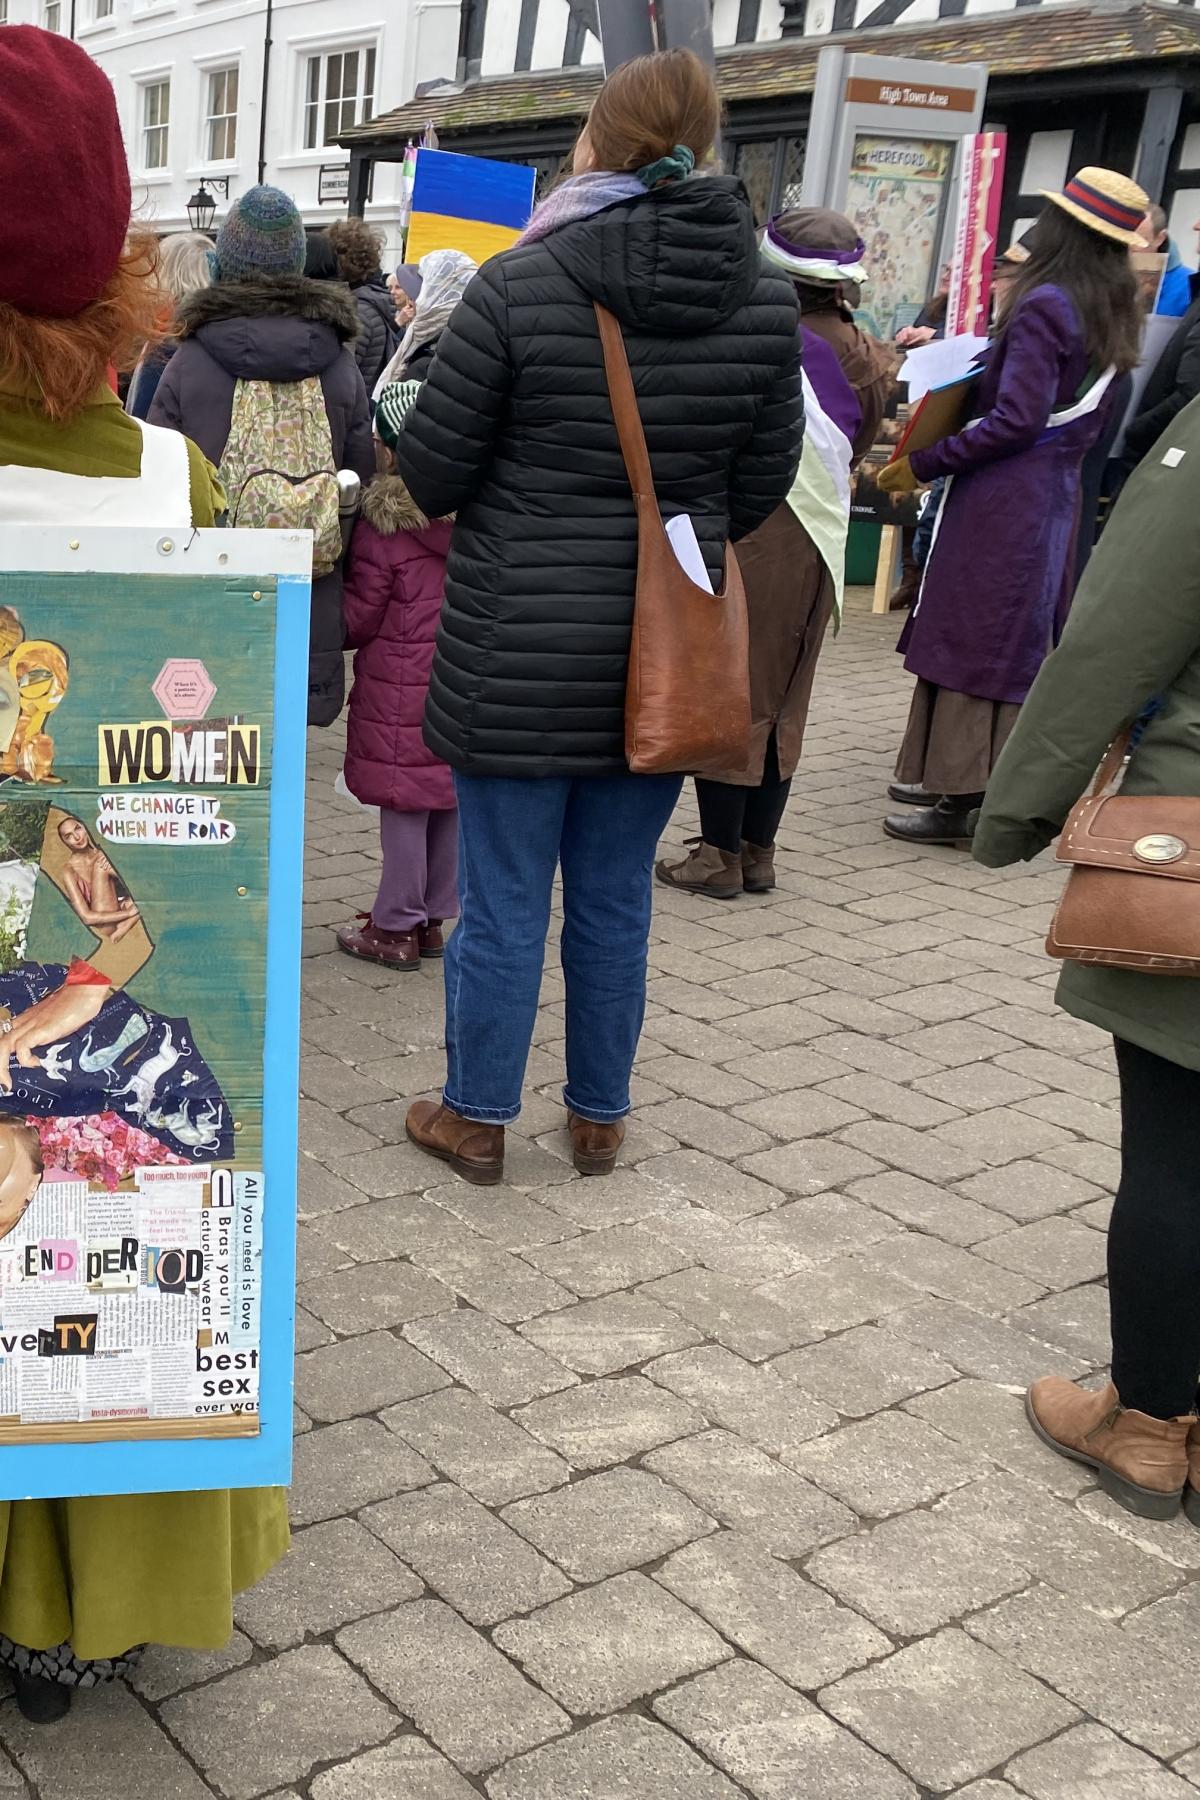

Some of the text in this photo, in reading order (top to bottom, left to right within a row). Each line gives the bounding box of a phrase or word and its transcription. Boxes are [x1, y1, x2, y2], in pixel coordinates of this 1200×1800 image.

[880, 86, 948, 106] High Town Area
[870, 150, 926, 167] HEREFORD
[103, 725, 258, 784] WOMEN
[101, 796, 218, 815] WE CHANGE IT
[100, 820, 230, 840] WHEN WE ROAR
[144, 1171, 208, 1182] Too much, too young
[24, 1244, 74, 1276] END
[241, 1178, 258, 1330] All you need is love
[216, 1217, 232, 1316] Bras you'll
[202, 1279, 211, 1324] wear
[196, 1349, 258, 1372] best
[203, 1378, 250, 1397] sex
[91, 1408, 148, 1417] Insta-dysmorphia
[195, 1403, 224, 1413] ever
